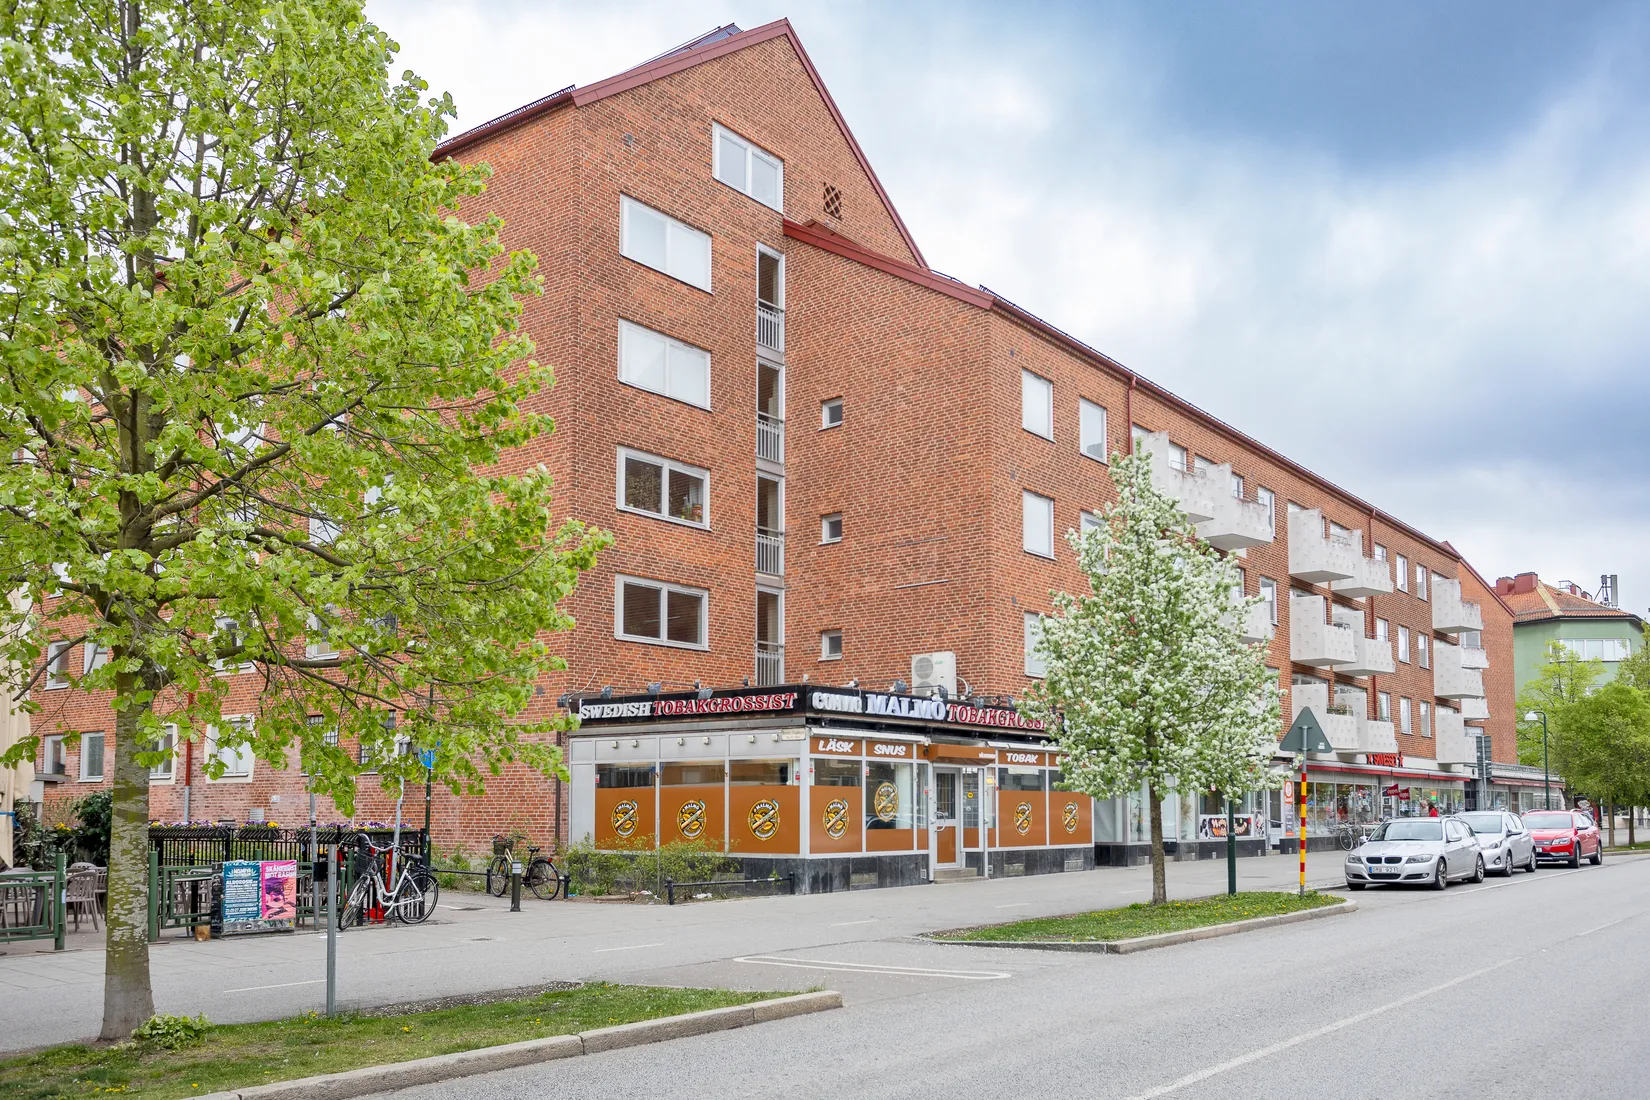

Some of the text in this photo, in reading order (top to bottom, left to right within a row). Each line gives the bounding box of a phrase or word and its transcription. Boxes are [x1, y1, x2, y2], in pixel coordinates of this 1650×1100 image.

[581, 692, 798, 719] SWEDISH TOBAKGROSSIST
[865, 692, 947, 720] MALMÖ
[947, 703, 1062, 730] TOBAKGROSSI
[818, 738, 854, 753] LÄSK
[873, 743, 906, 756] SNUS
[1006, 752, 1039, 764] TOBAK
